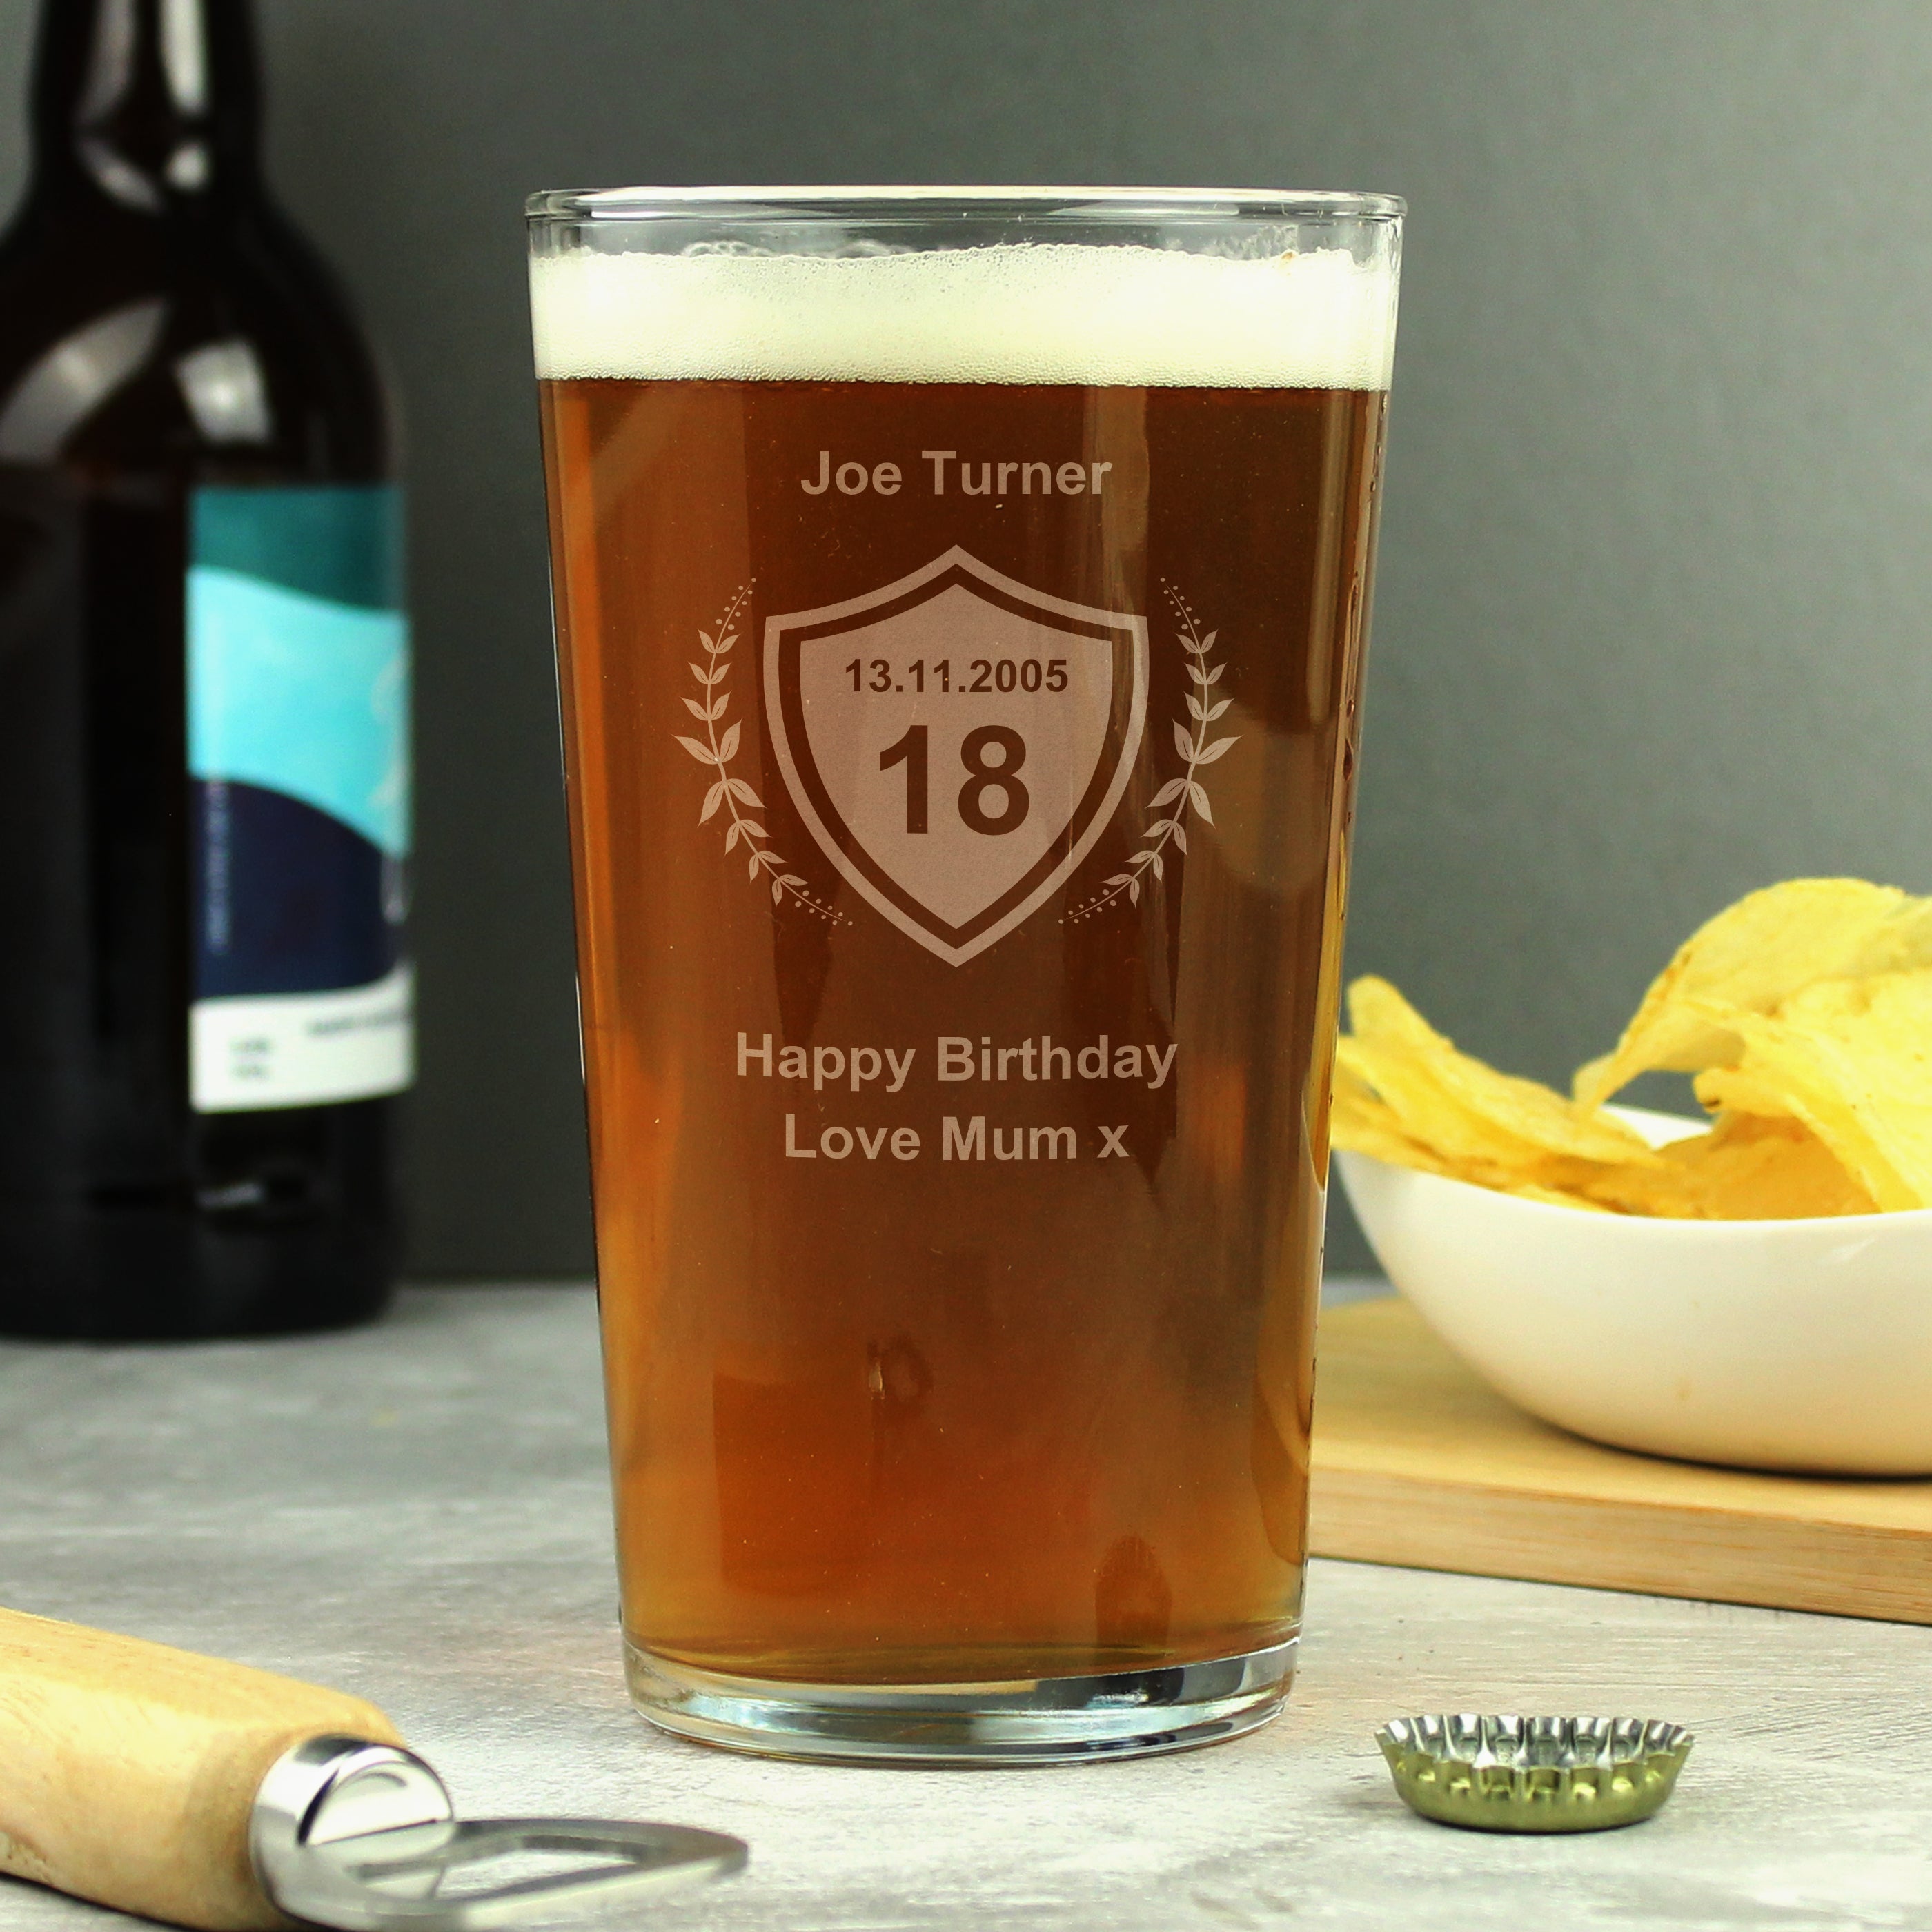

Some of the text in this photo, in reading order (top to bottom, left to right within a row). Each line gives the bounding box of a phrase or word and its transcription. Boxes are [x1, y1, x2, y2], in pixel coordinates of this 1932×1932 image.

[800, 450, 1113, 495] Joe Turner
[844, 658, 1069, 693] 13.11.2005
[878, 724, 1030, 836] 18
[736, 1032, 1179, 1093] Happy Birthday
[785, 1113, 1130, 1161] Love Mum x
